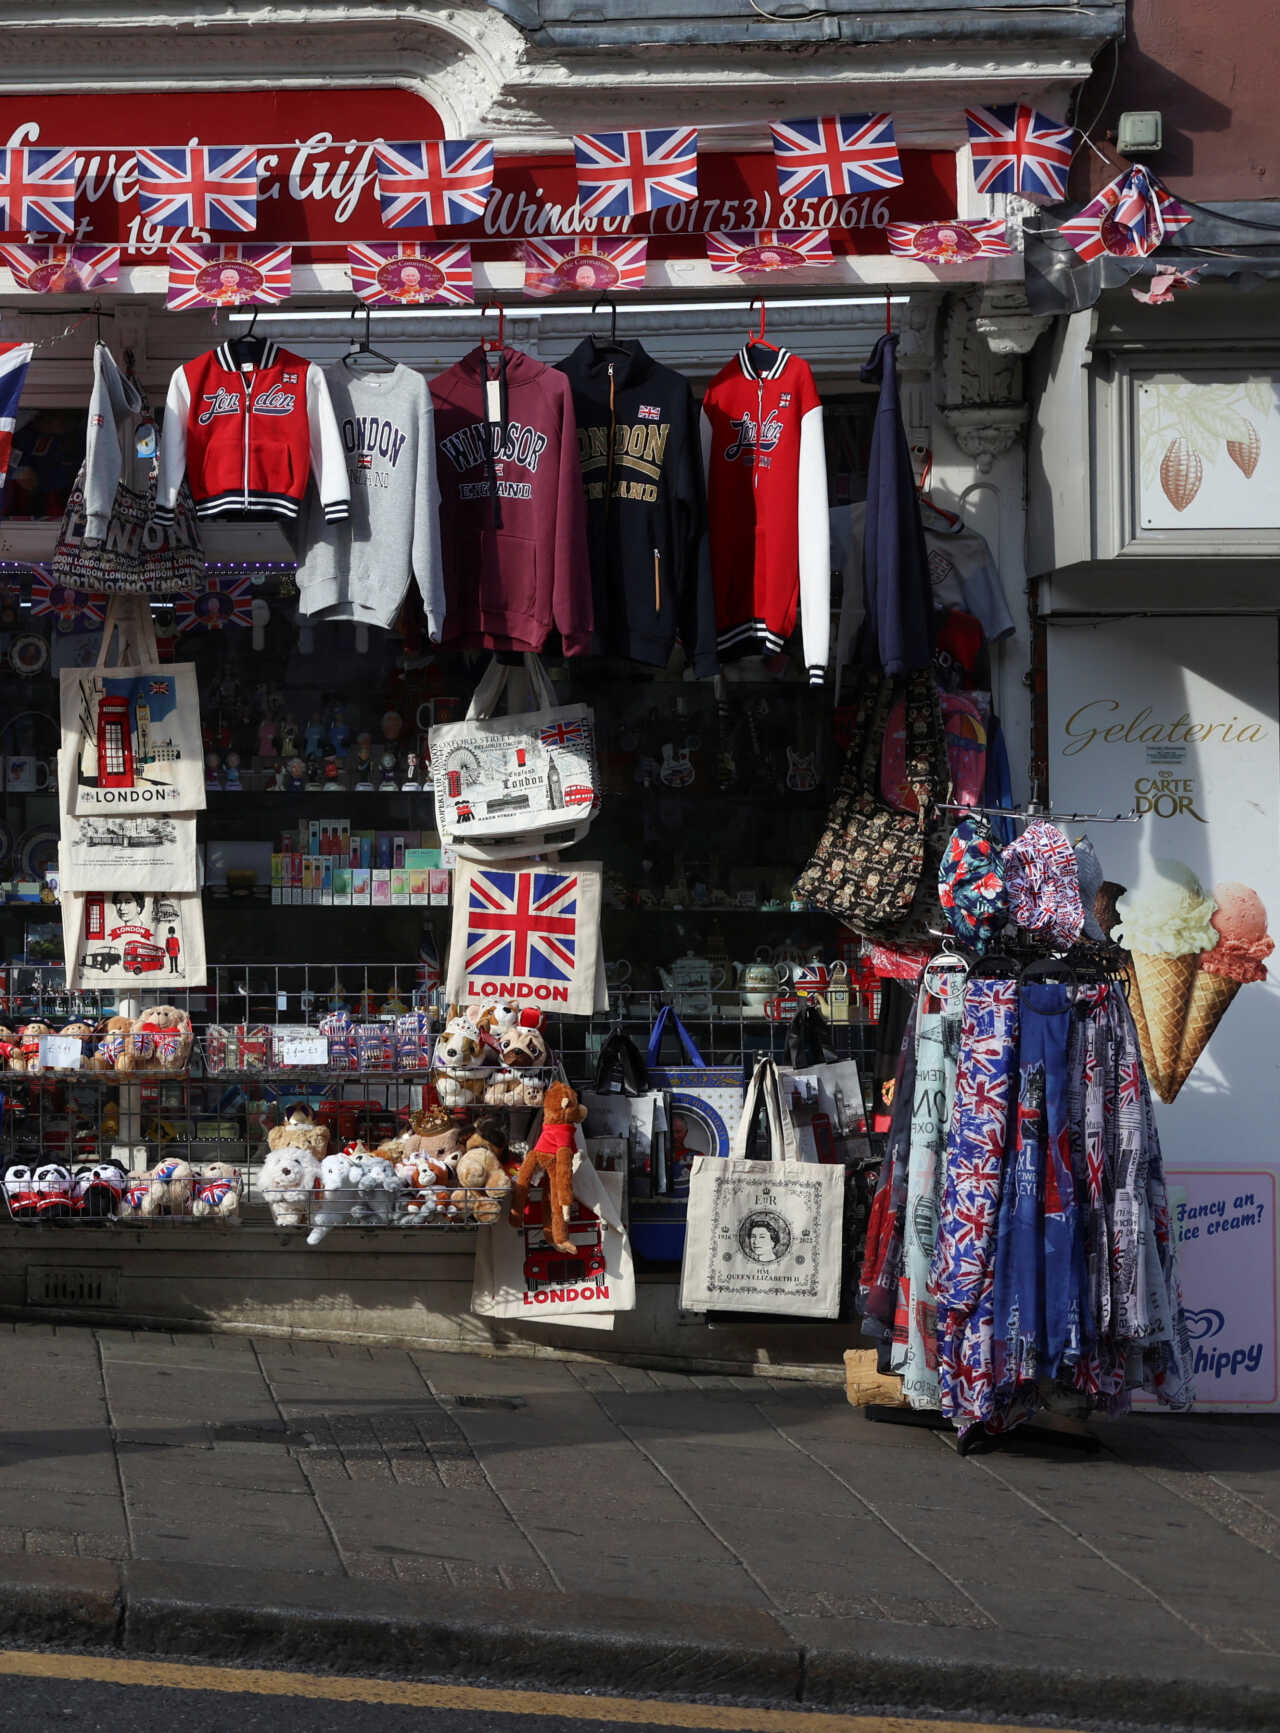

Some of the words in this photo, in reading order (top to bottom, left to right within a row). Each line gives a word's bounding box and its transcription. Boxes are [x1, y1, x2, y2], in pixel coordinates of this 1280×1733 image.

[649, 190, 771, 231] (01753)
[778, 195, 890, 230] 850616
[342, 415, 408, 470] ONDON
[576, 423, 671, 466] ONDON
[457, 481, 532, 499] ENGAND
[1062, 699, 1270, 757] Gelateria
[95, 788, 167, 804] LONDON
[502, 775, 544, 790] London
[1134, 777, 1193, 796] CARTE
[1135, 792, 1211, 824] D'OR
[116, 926, 146, 934] LONDON
[467, 980, 569, 1002] LONDON
[1176, 1201, 1226, 1223] Fancy
[1233, 1193, 1255, 1209] an
[1178, 1224, 1200, 1243] ice
[1206, 1203, 1265, 1237] cream?
[522, 1285, 610, 1305] LONDON
[1194, 1342, 1264, 1379] hippy
